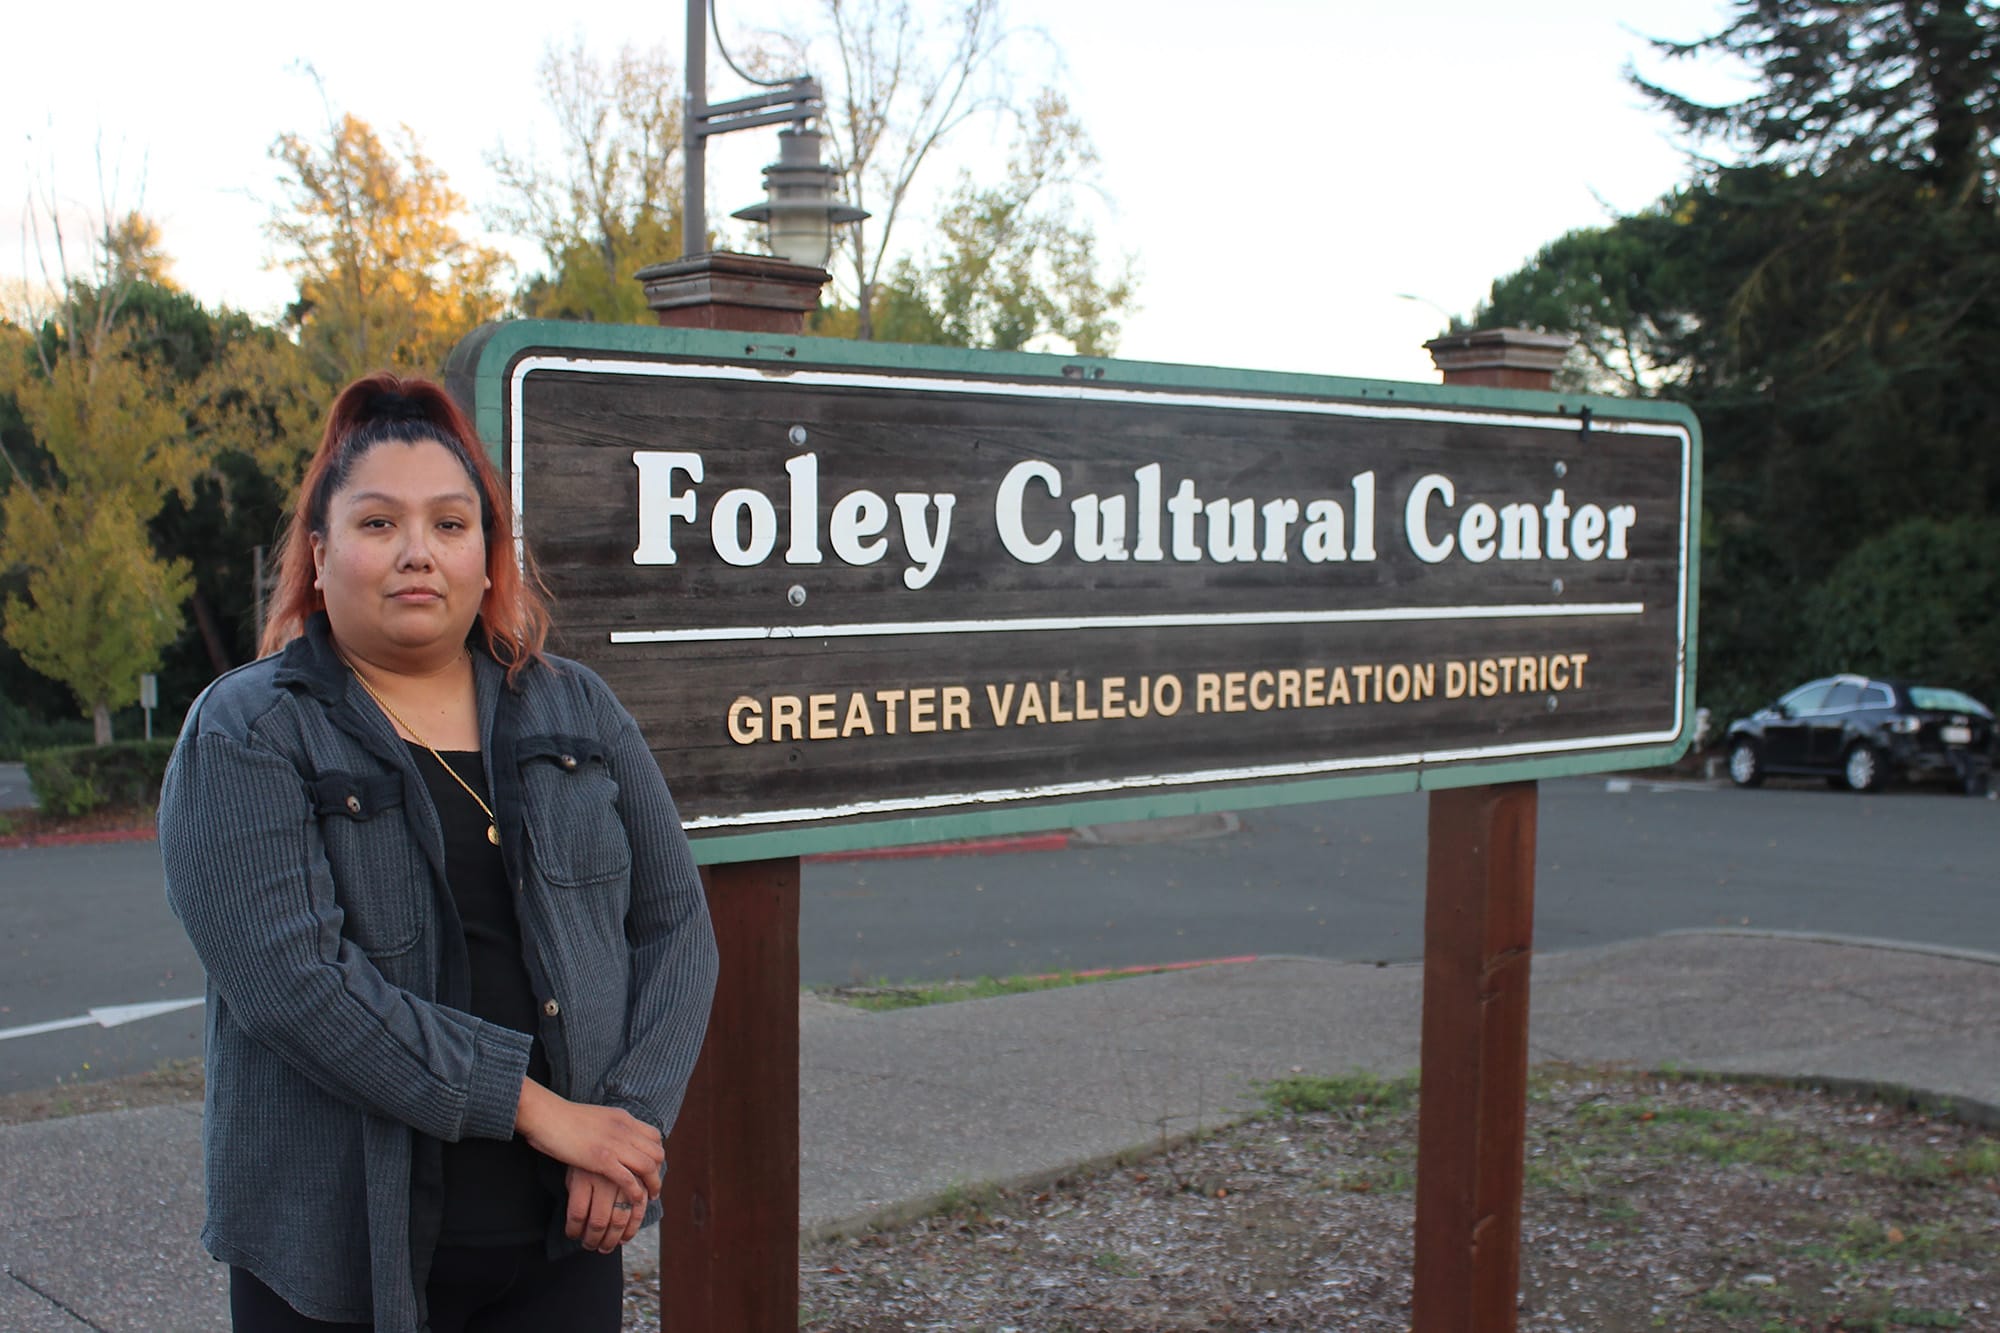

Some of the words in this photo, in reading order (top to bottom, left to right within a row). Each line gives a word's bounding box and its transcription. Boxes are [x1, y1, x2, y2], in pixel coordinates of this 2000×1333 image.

[632, 451, 956, 589] Foley
[995, 460, 1377, 564] Cultural
[1405, 474, 1636, 563] Center
[727, 686, 972, 745] GREATER
[986, 675, 1183, 727] VALLEJO
[1196, 663, 1436, 714] RECREATION
[1445, 654, 1589, 700] DISTRICT
